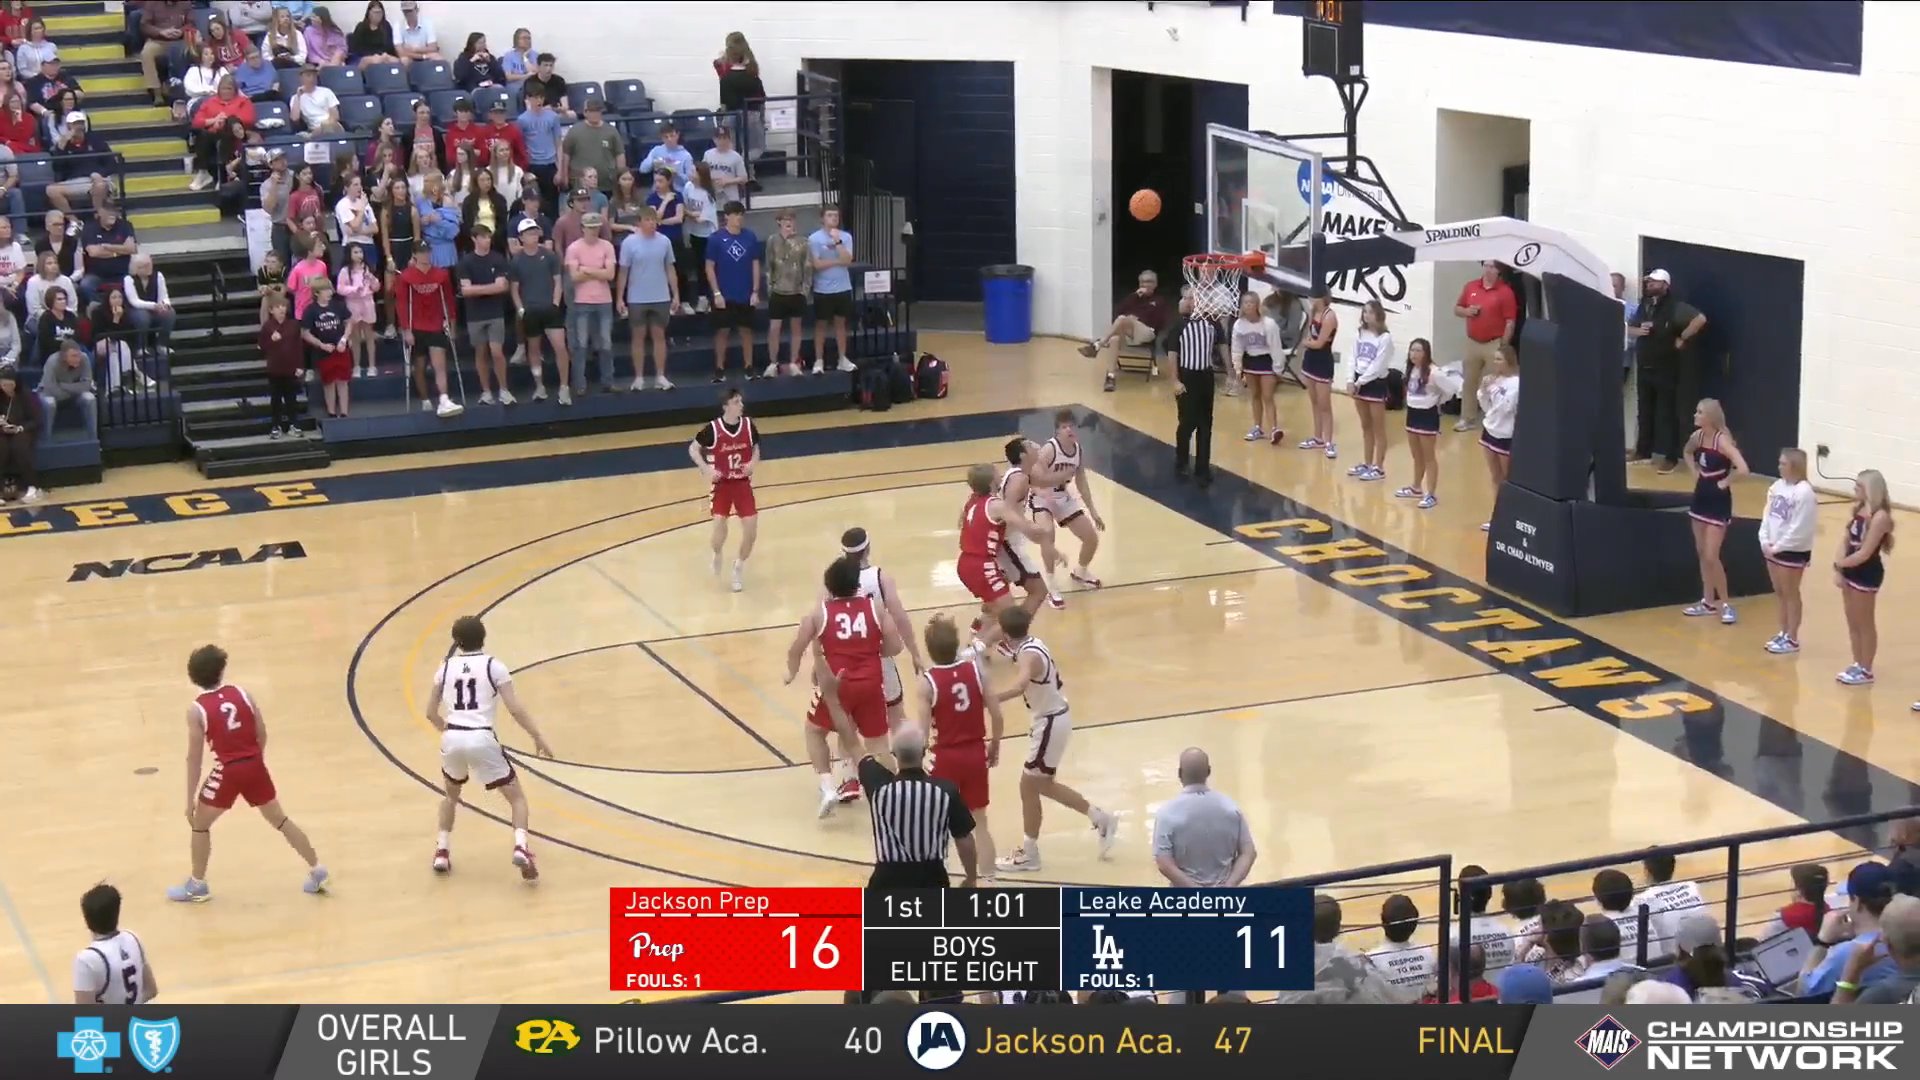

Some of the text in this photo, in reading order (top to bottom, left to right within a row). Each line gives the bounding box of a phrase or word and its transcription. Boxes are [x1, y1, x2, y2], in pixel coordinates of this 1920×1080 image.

[1321, 211, 1386, 237] MAKE
[1425, 224, 1480, 243] SPALDING
[728, 453, 741, 469] 12
[1515, 520, 1536, 536] BETSY
[66, 540, 307, 582] NCAA
[1507, 545, 1524, 560] CHAD
[1524, 552, 1554, 573] ALTMYER
[834, 611, 868, 640] 34
[1233, 517, 1713, 720] CHOCTAWS
[454, 678, 479, 710] 11
[951, 682, 971, 712] 3
[220, 702, 242, 730] 2
[122, 965, 138, 1005] 5
